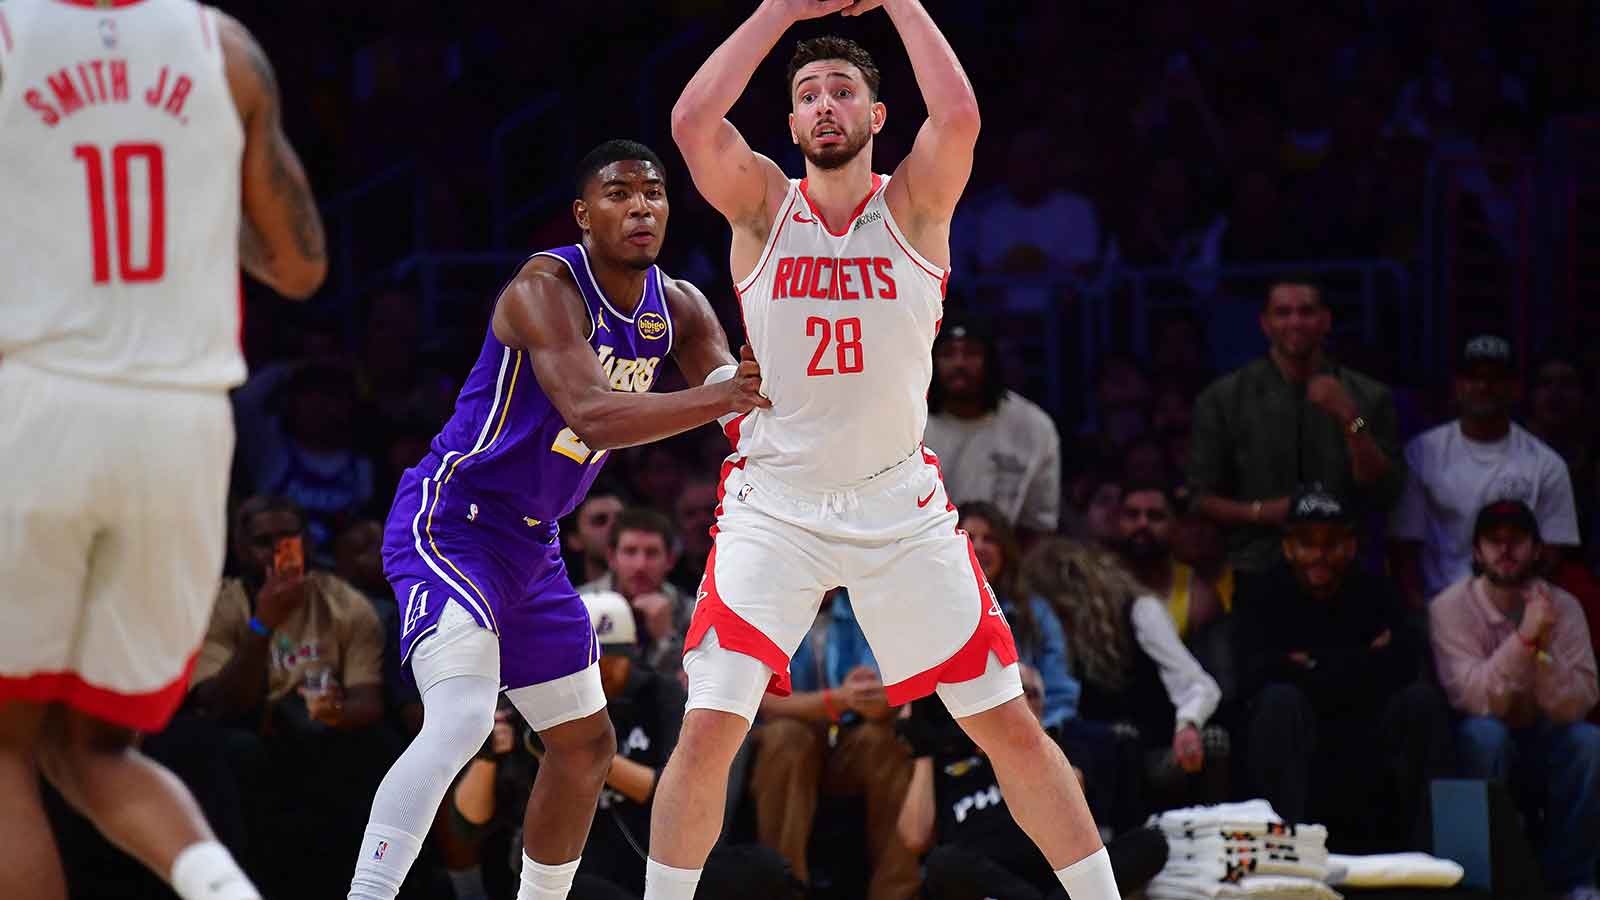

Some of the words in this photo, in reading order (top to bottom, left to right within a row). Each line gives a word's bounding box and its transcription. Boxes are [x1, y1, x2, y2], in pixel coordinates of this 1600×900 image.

[23, 59, 130, 128] SMITH
[145, 64, 193, 125] JR.
[72, 143, 166, 286] 10
[640, 319, 665, 333] bibigo
[806, 316, 864, 376] 28
